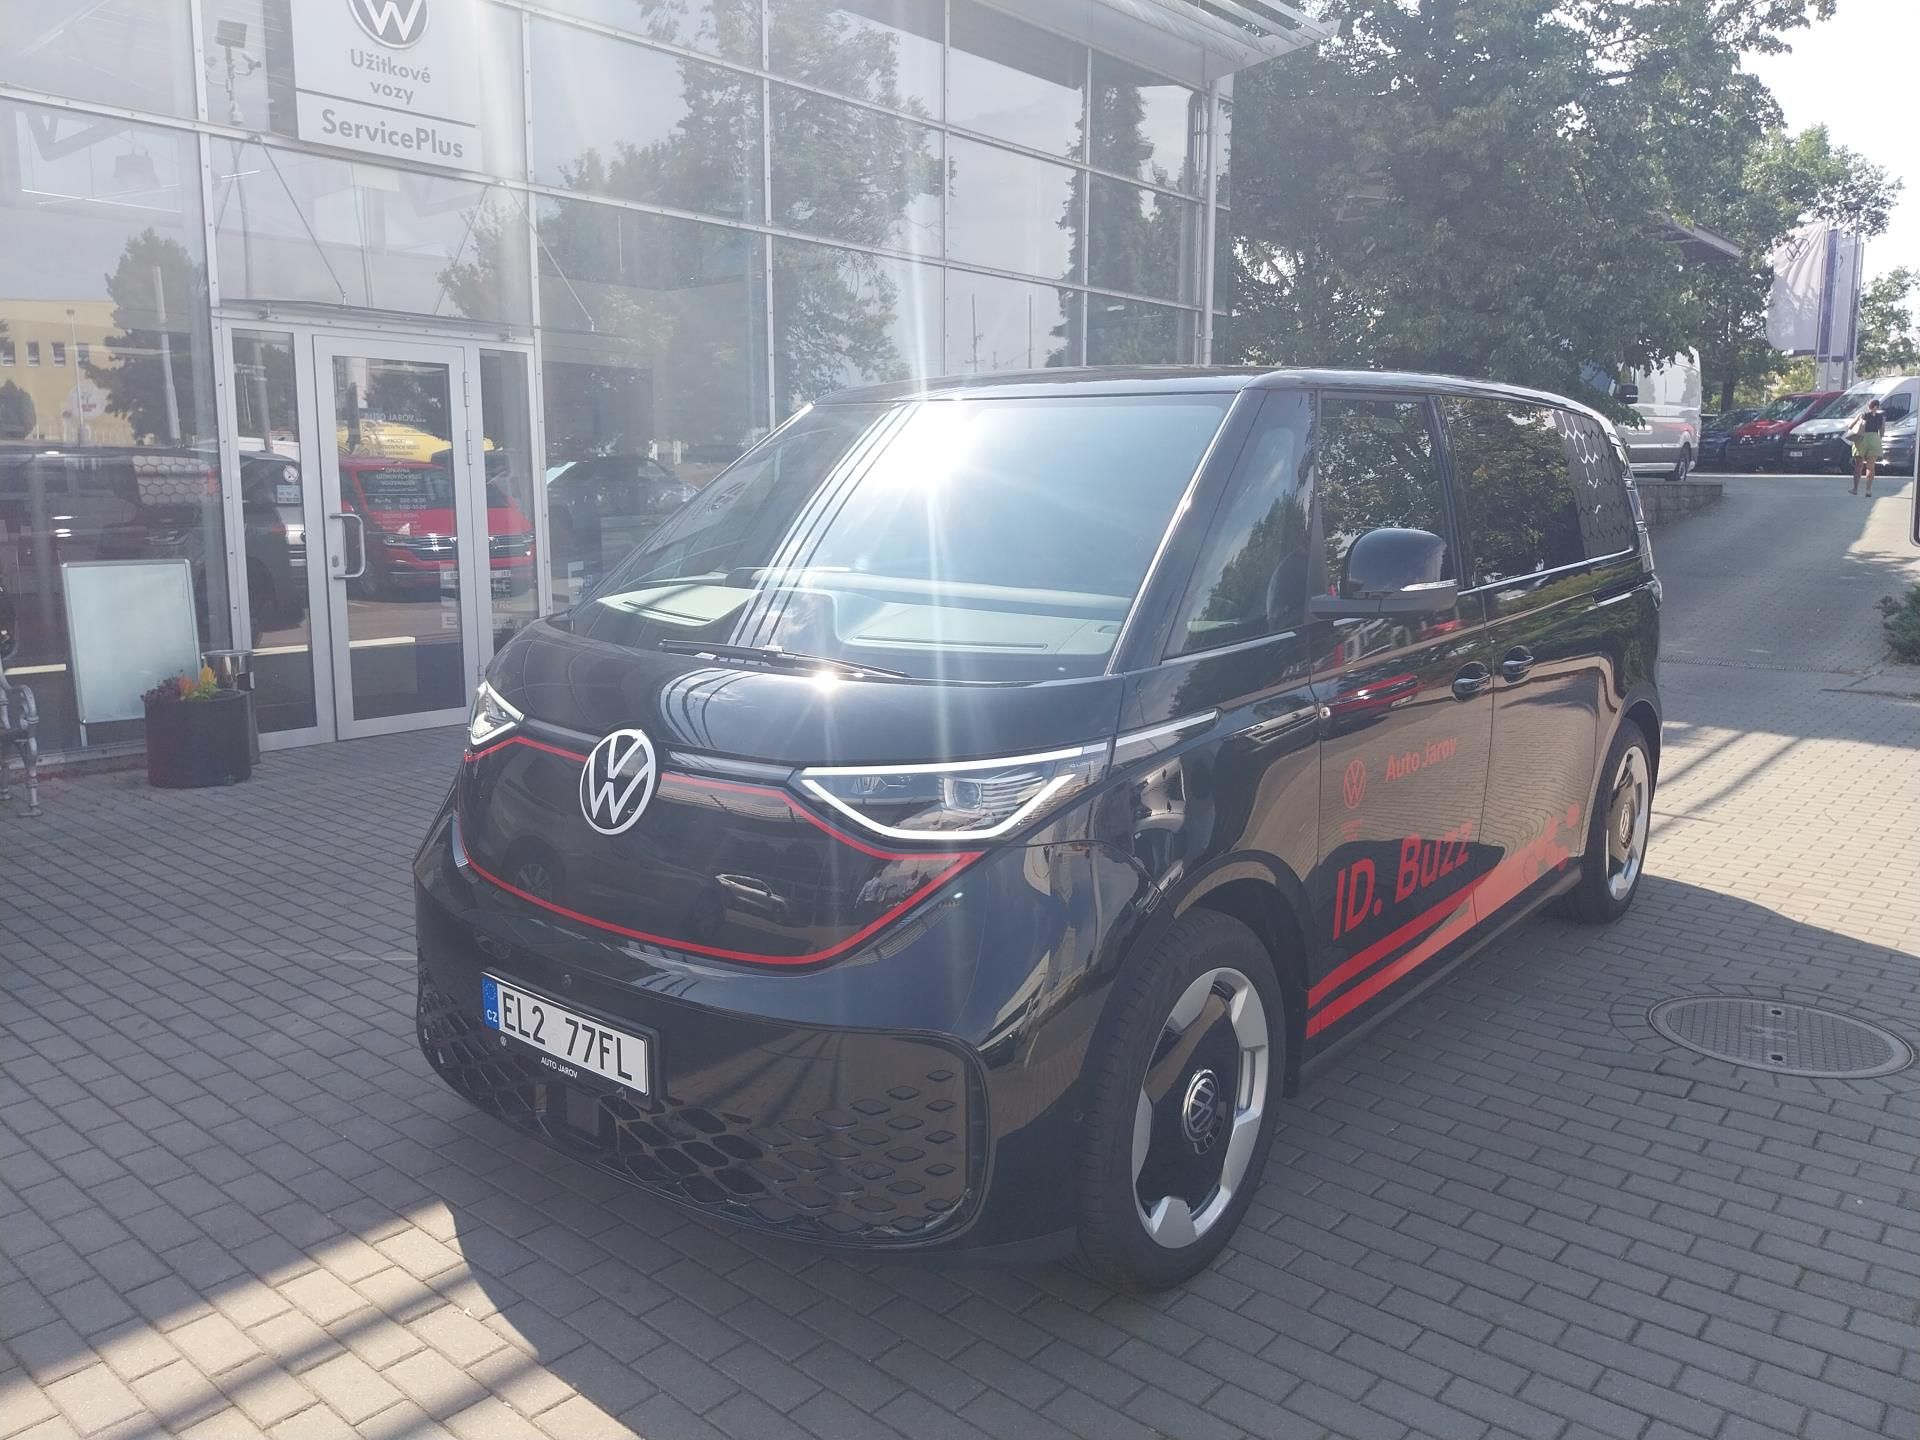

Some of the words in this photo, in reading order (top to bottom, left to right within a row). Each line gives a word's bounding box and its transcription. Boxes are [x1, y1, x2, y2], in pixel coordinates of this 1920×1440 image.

[350, 48, 432, 84] Užitkové
[370, 81, 414, 105] vozy
[321, 108, 464, 158] ServicePlus
[1384, 752, 1420, 784] Auto
[1422, 736, 1457, 768] Jarov
[1333, 858, 1383, 941] ID.
[486, 1009, 498, 1023] CZ
[502, 991, 546, 1045] EL2
[565, 1017, 632, 1082] 77FL
[540, 1056, 558, 1071] AUTO
[558, 1063, 579, 1079] JAROV
